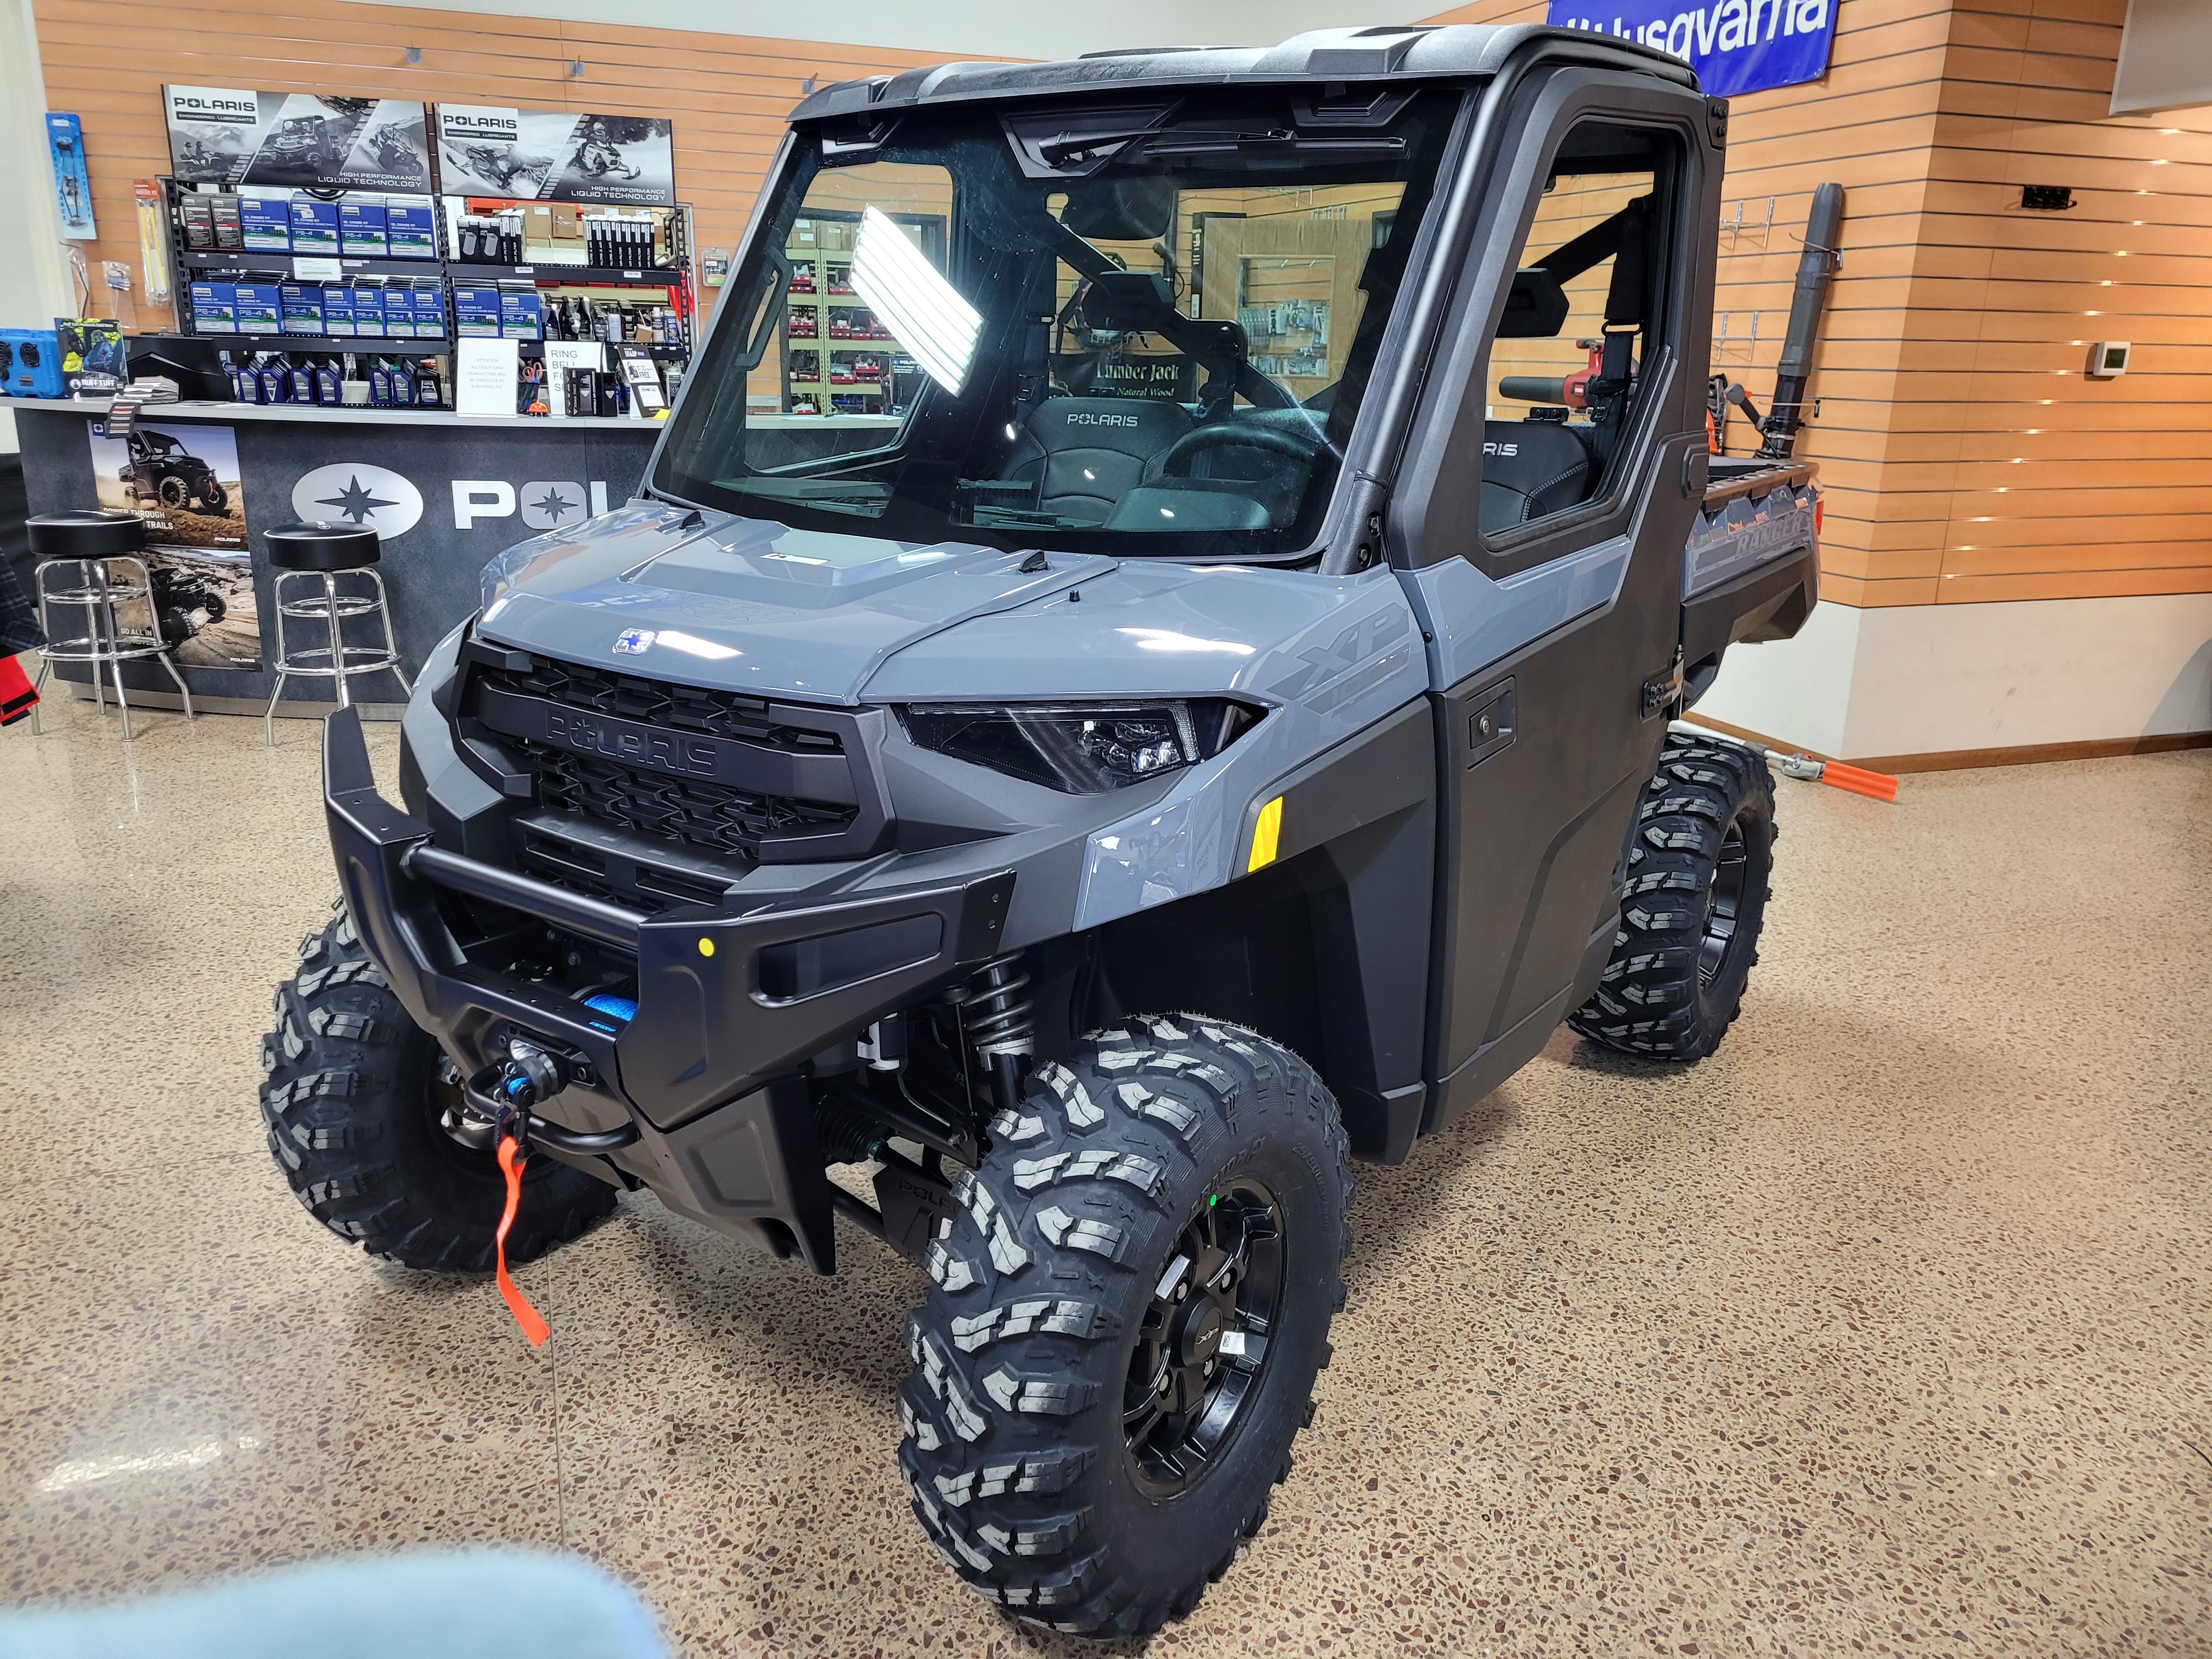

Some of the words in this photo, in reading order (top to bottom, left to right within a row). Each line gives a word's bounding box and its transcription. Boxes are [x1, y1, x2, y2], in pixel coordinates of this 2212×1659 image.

[173, 97, 256, 112] POLARIS
[443, 115, 517, 128] POLARIS
[360, 173, 422, 181] PERFORMANCE
[353, 178, 422, 188] TECHNOLOGY
[610, 187, 665, 195] PERFORMANCE
[603, 192, 665, 201] TECHNOLOGY
[551, 350, 578, 358] RING
[1097, 362, 1147, 380] Lumber
[1149, 364, 1180, 382] Jack
[1117, 387, 1147, 397] Natural
[1150, 387, 1175, 397] Wood
[1066, 413, 1138, 428] POLARIS
[130, 510, 165, 519] THROUGH
[145, 521, 174, 530] TRAILS
[1734, 511, 1803, 560] RANGER
[1263, 601, 1410, 702] XP
[545, 710, 717, 776] POLARIS
